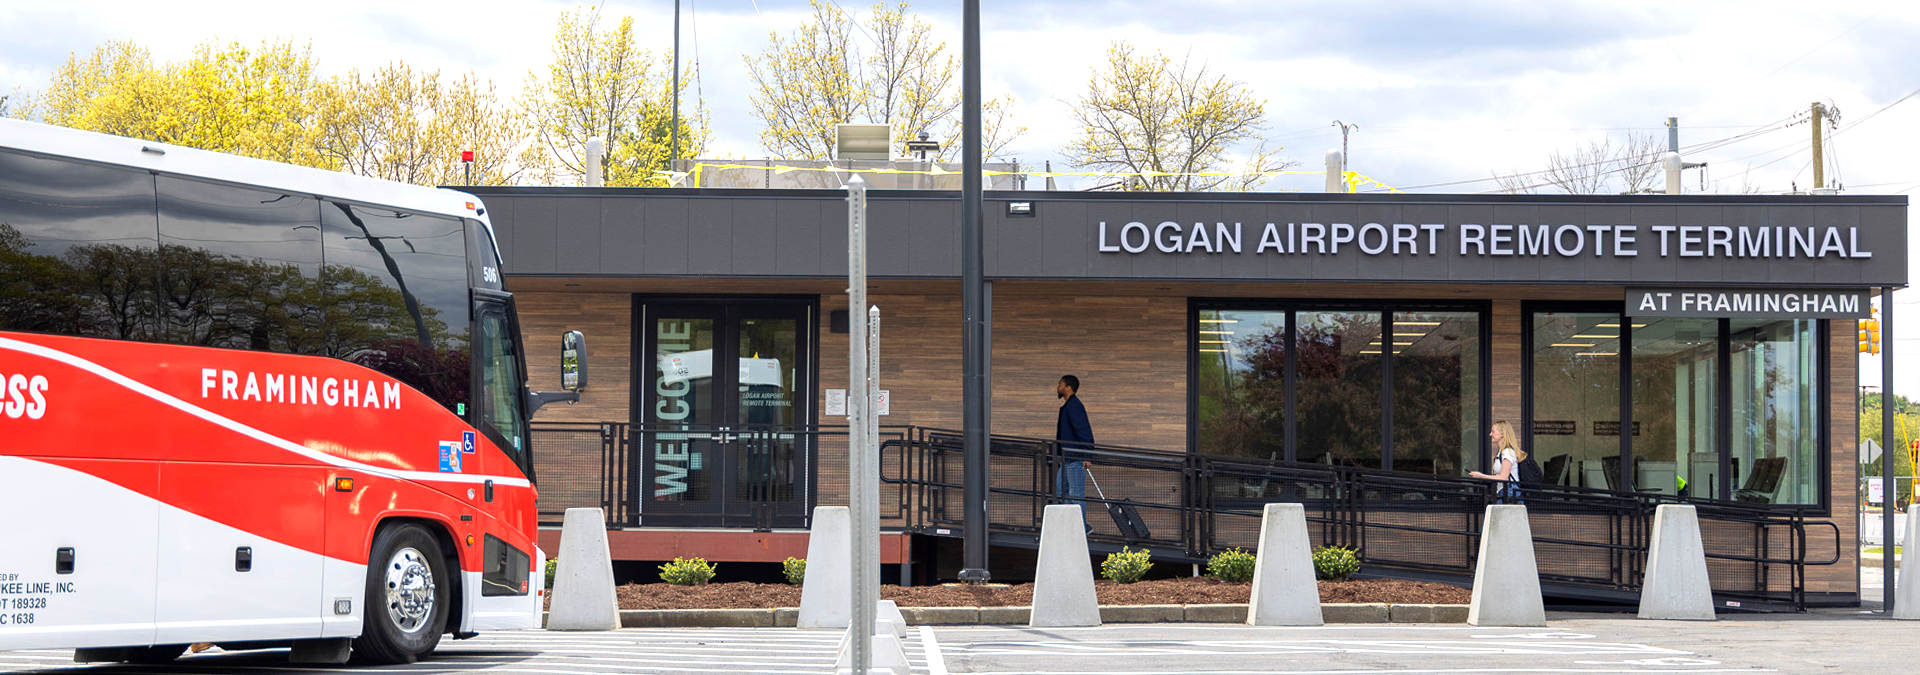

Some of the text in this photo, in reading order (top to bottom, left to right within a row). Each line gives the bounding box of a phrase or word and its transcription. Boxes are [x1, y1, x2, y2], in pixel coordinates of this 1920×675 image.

[1098, 221, 1872, 258] LOGAN AIRPORT REMOTE TERMINAL
[483, 266, 497, 283] 506
[1638, 292, 1860, 314] AT FRAMINGHAM
[201, 367, 401, 410] FRAMINGHAM
[8, 573, 20, 582] BY
[26, 582, 53, 596] LINE,
[56, 581, 77, 594] INC.
[11, 597, 47, 609] 189328
[11, 612, 35, 625] 1638
